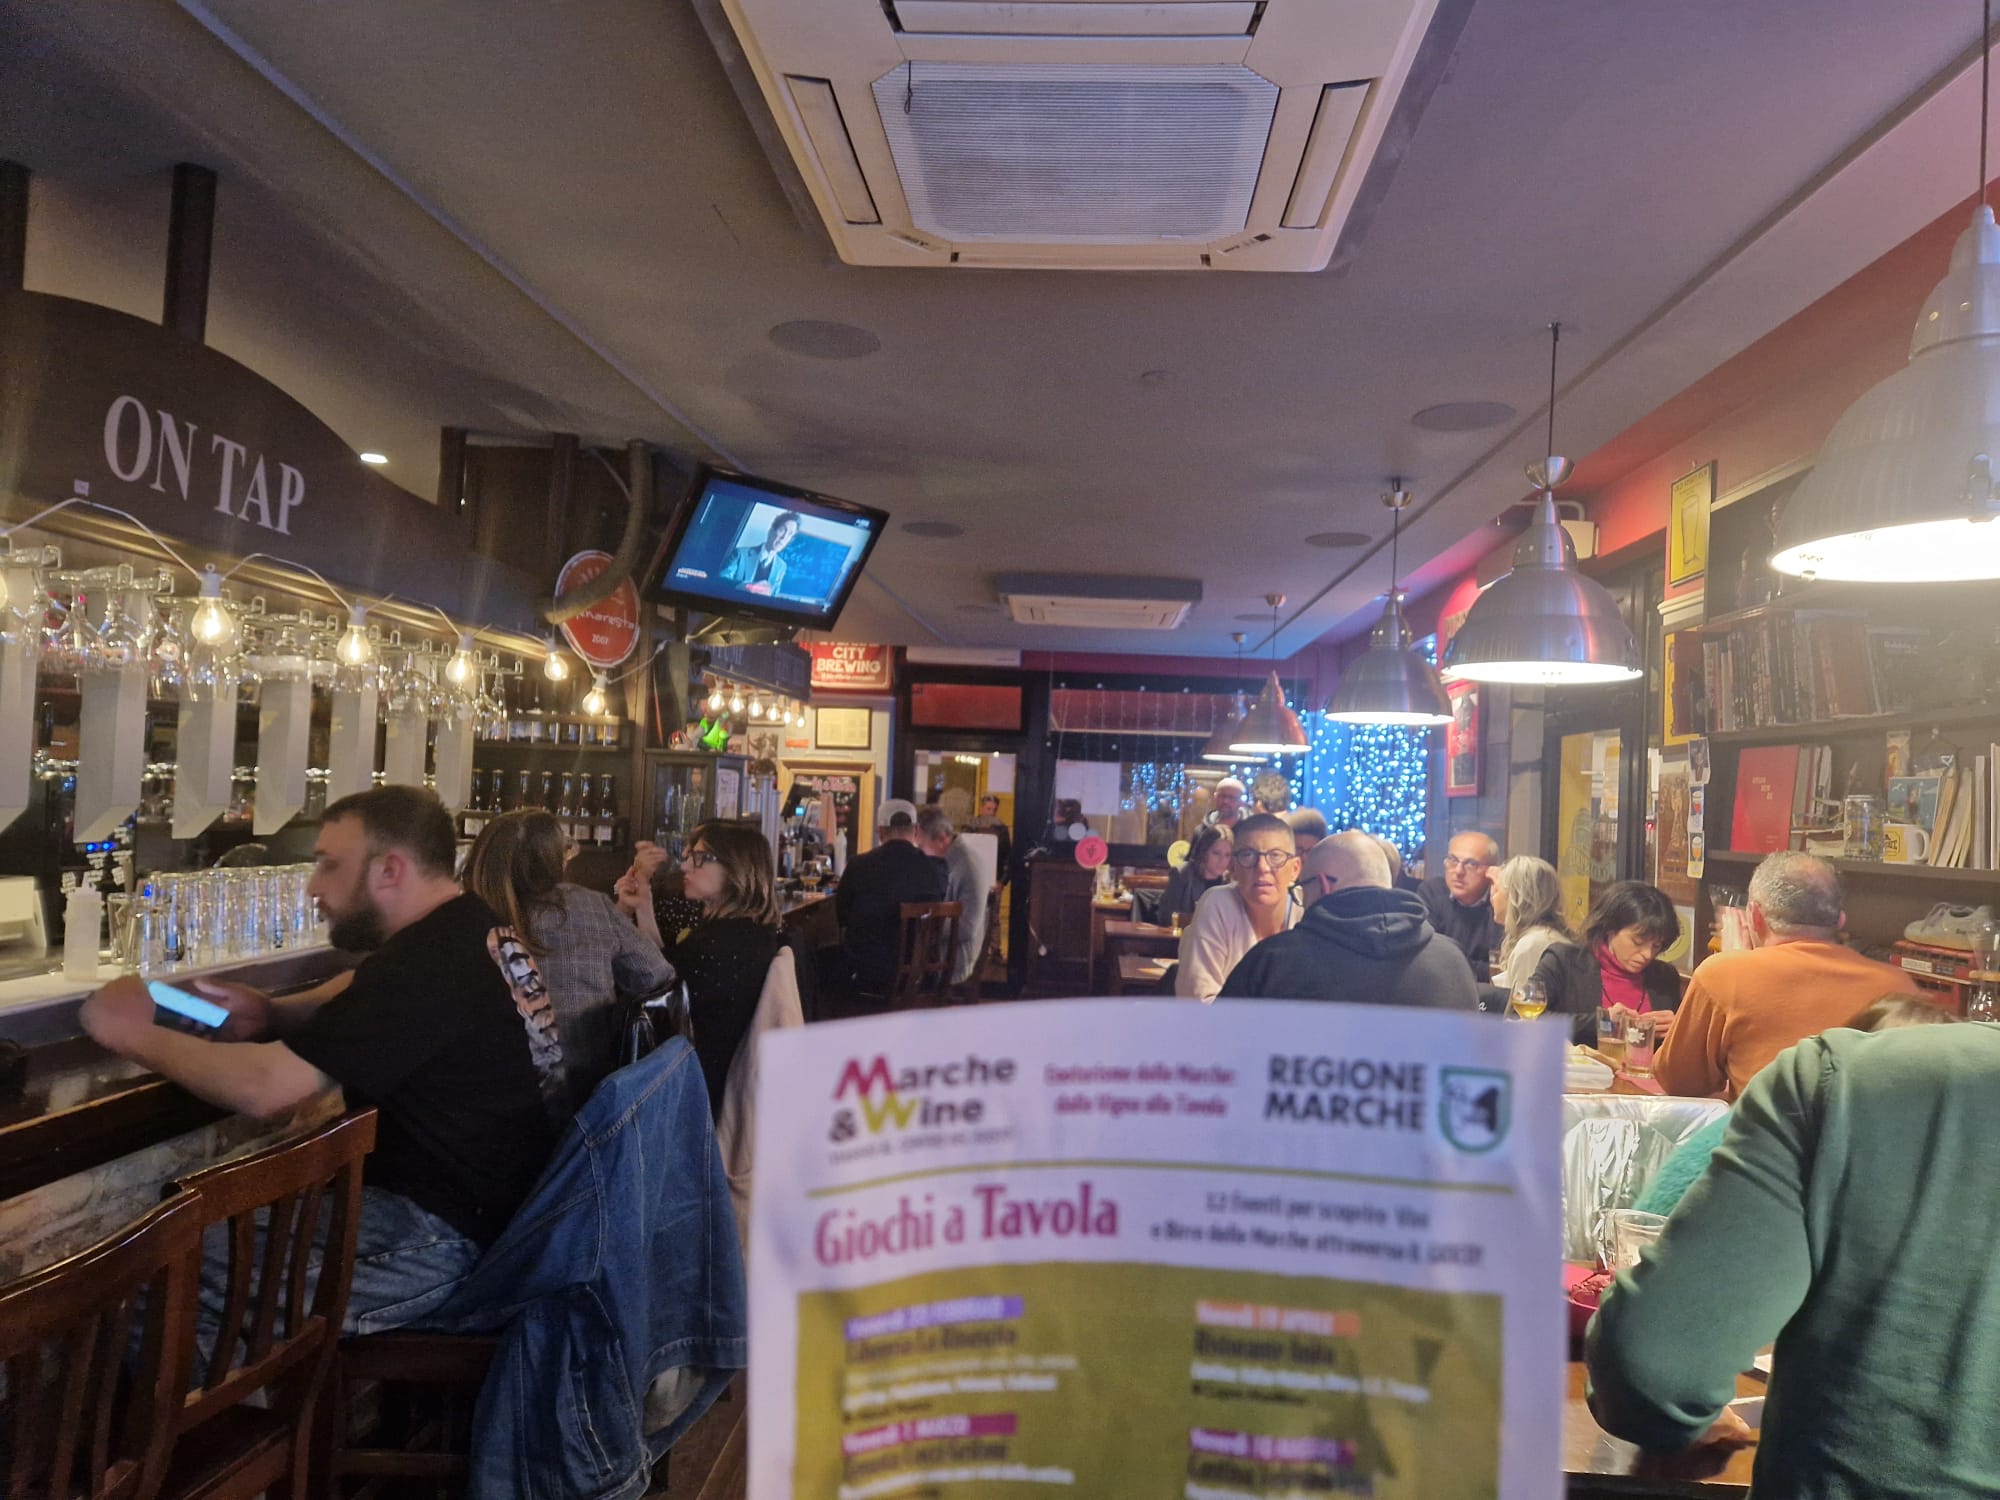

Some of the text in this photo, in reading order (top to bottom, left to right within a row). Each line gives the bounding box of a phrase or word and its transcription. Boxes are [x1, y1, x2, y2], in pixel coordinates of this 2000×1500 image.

[104, 395, 305, 535] ON TAP
[816, 658, 881, 673] BREWING
[832, 646, 866, 659] CITY
[834, 1054, 1017, 1101] Marche
[1268, 1055, 1427, 1095] REGIONE
[1263, 1091, 1426, 1132] MARCHE
[815, 1180, 1119, 1267] Giochi a Tavola
